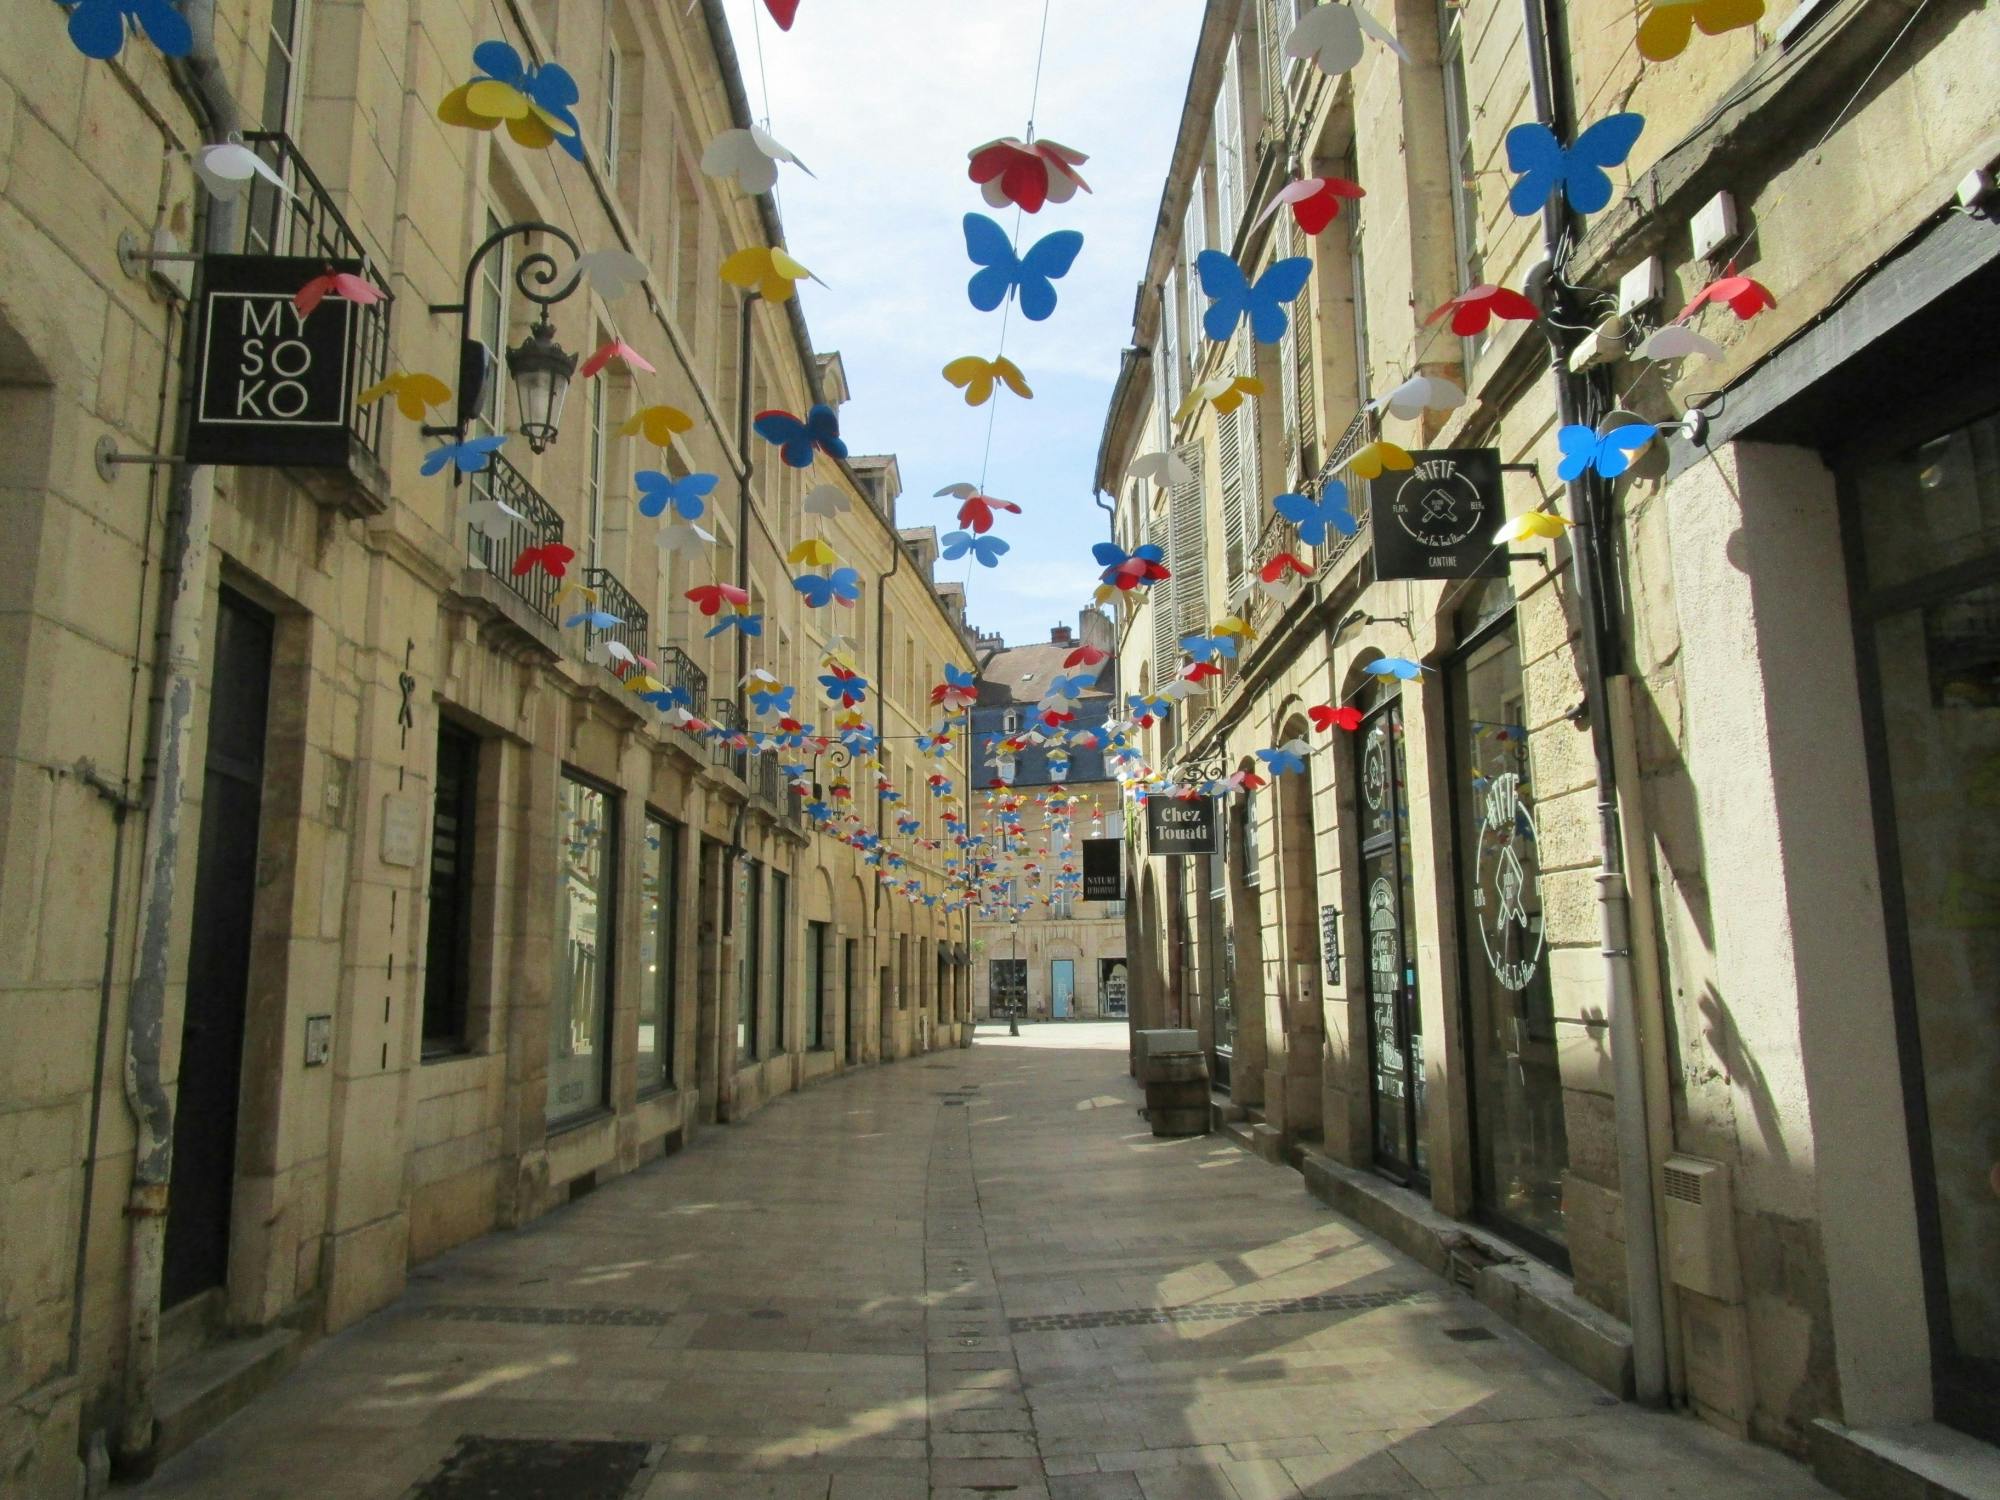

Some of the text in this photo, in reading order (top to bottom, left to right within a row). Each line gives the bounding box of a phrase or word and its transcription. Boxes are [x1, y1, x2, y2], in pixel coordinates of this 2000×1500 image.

[241, 299, 310, 337] MY
[240, 338, 311, 377] SO
[236, 379, 309, 418] KO
[1413, 459, 1457, 482] #TFTF
[1428, 555, 1457, 568] CANTINE
[1161, 807, 1201, 822] Chez
[1486, 773, 1520, 831] #TFTF
[1155, 824, 1207, 840] Touati
